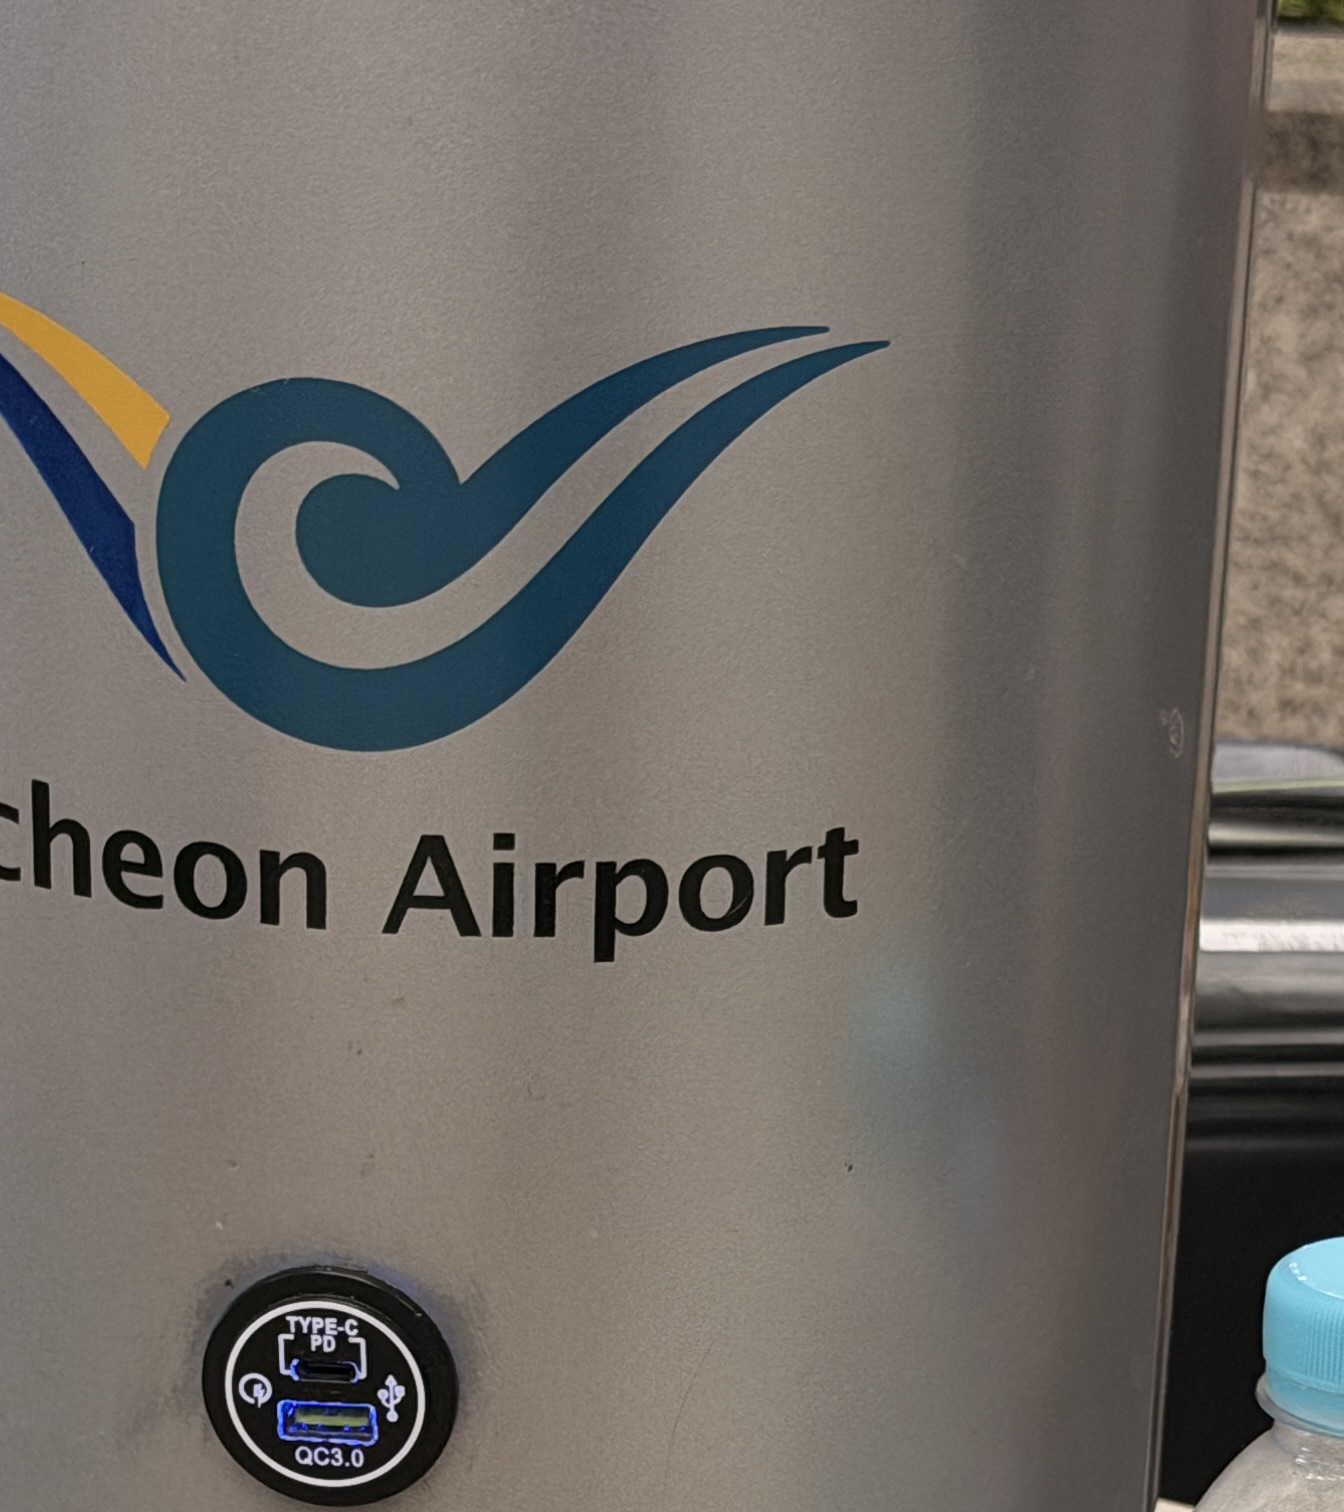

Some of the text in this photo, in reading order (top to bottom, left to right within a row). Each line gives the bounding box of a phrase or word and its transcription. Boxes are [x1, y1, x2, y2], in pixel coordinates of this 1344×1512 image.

[380, 825, 861, 965] Airport
[285, 1315, 360, 1336] TYPE-C
[310, 1334, 337, 1353] PD
[294, 1446, 365, 1468] QC3.0
